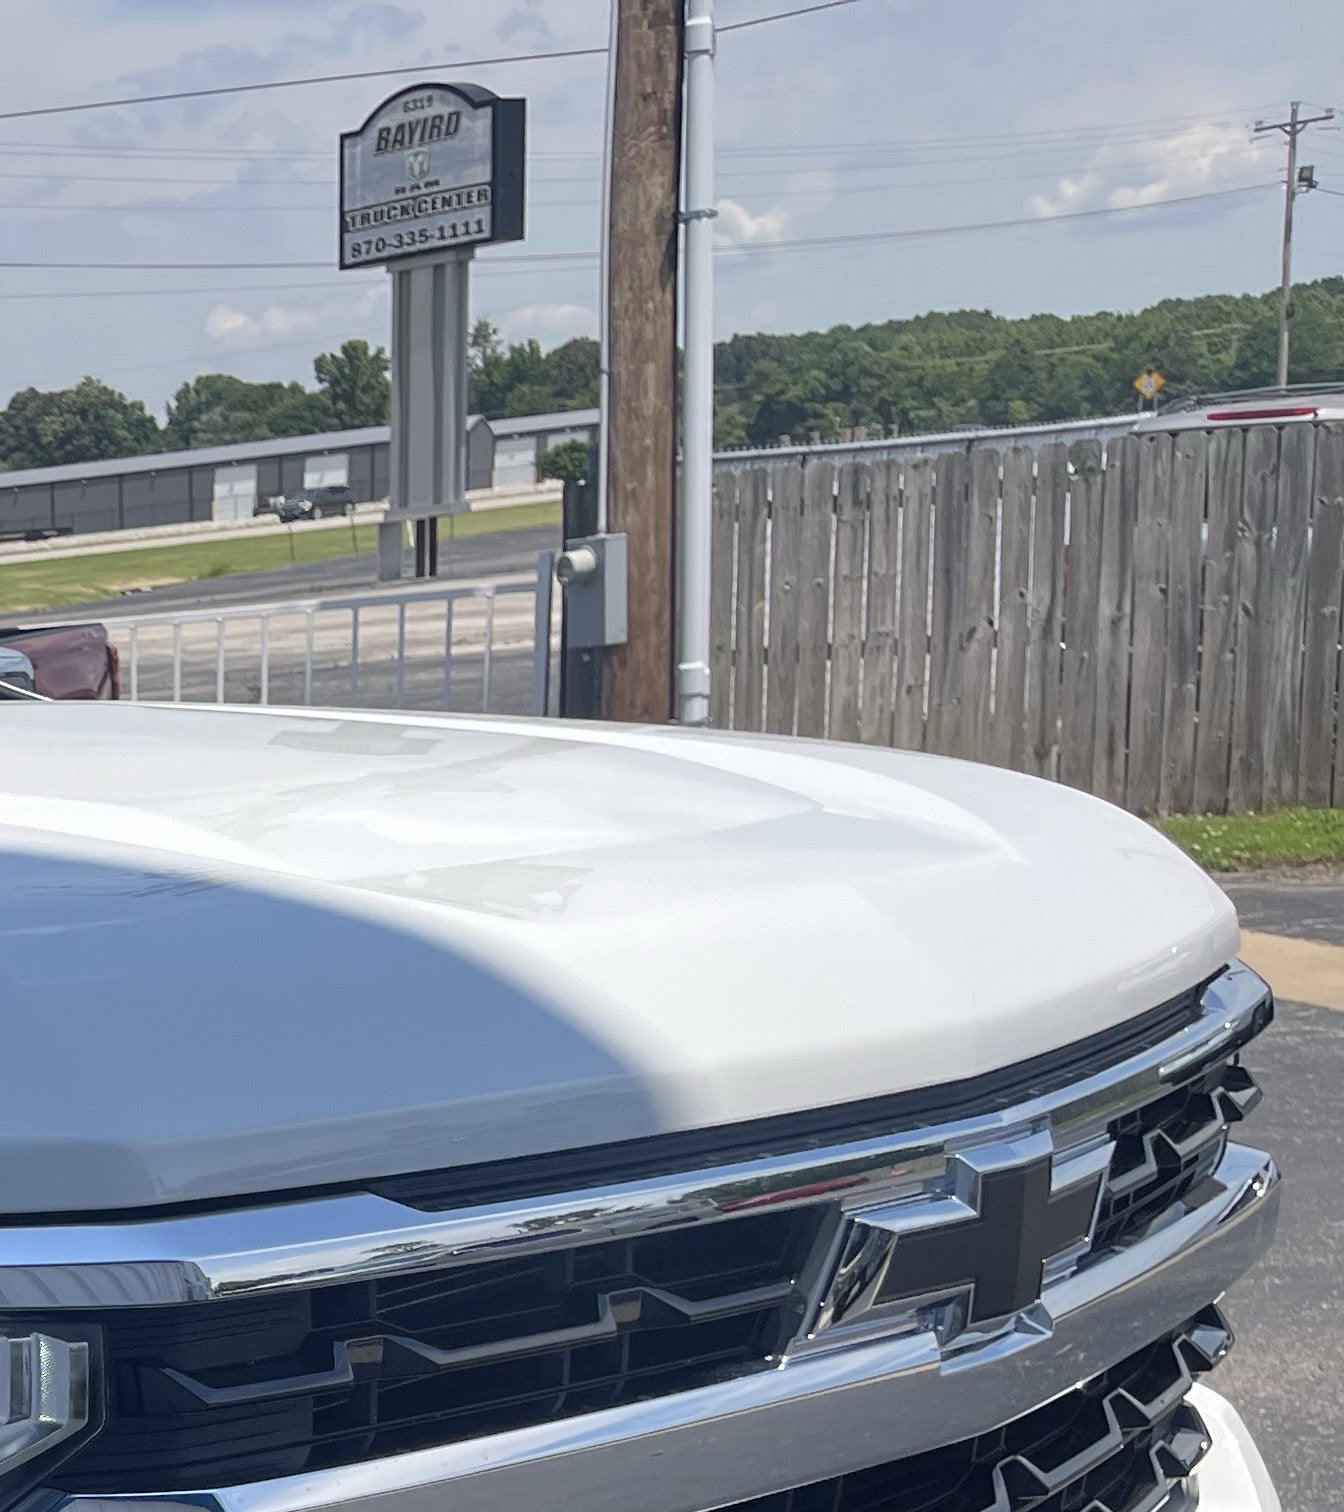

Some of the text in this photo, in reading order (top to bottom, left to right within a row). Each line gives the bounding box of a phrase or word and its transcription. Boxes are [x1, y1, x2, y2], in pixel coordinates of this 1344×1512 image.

[375, 111, 461, 152] BAYIRD
[346, 202, 412, 230] TRUCK
[416, 187, 490, 215] CENTER
[350, 218, 485, 260] 870-335-1111
